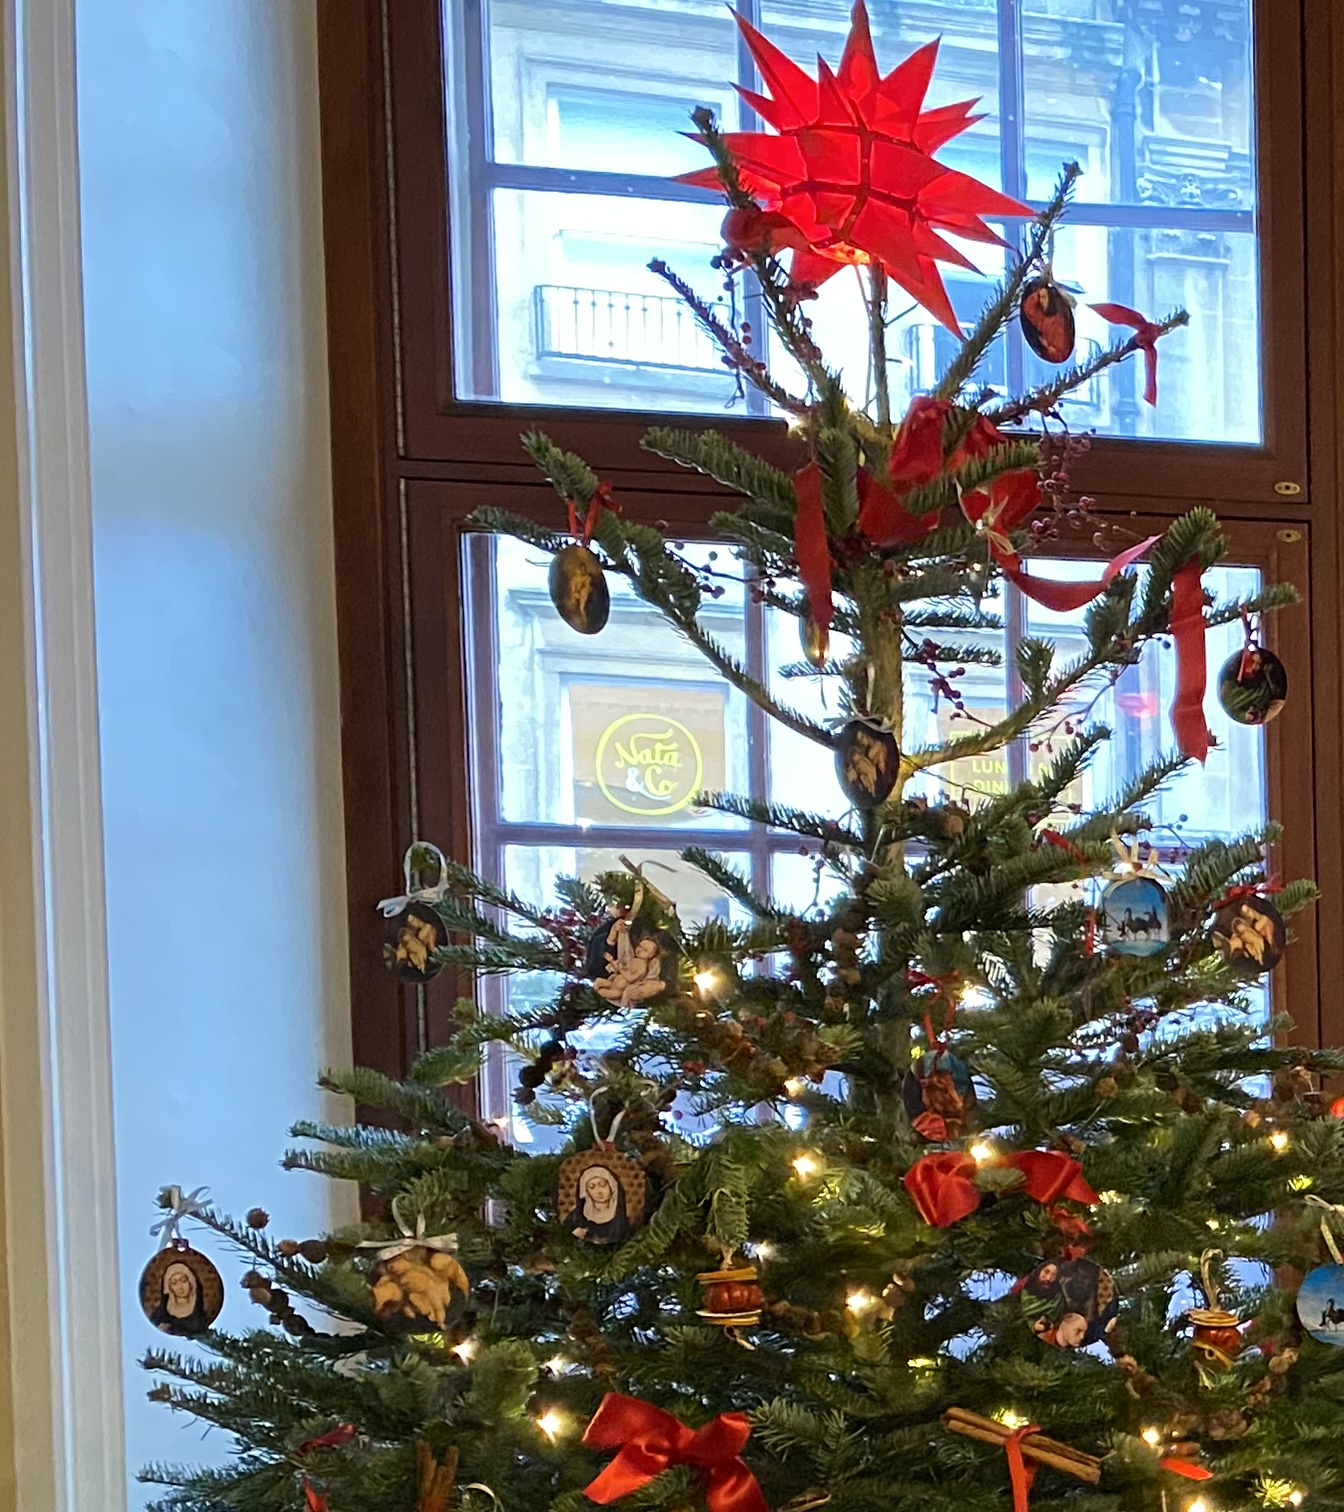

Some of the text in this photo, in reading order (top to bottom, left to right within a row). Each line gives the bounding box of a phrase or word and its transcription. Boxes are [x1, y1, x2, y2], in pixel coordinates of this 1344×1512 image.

[614, 728, 683, 768] Nata
[644, 765, 679, 796] Co
[972, 760, 1008, 774] LUN
